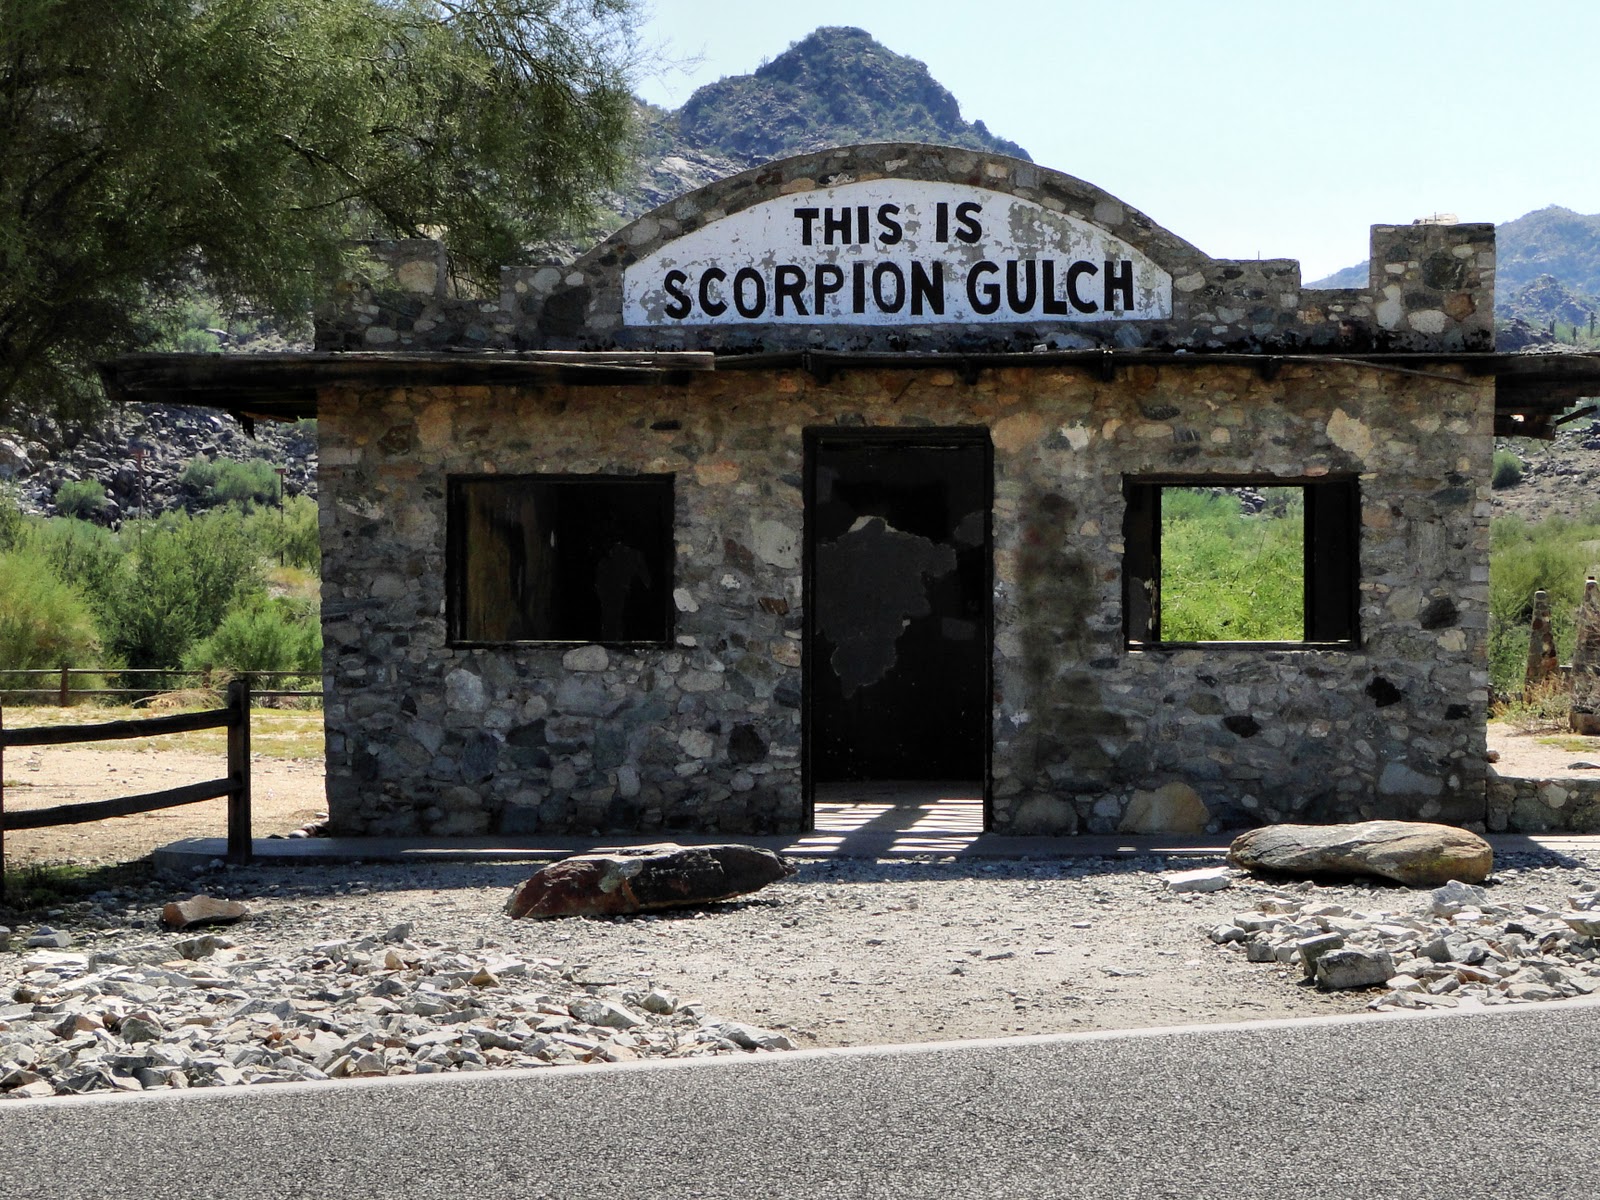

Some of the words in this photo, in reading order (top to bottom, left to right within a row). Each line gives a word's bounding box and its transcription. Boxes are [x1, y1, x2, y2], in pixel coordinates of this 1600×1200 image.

[794, 204, 901, 246] THIS
[936, 202, 983, 243] IS
[663, 260, 944, 319] SCORPION
[966, 259, 1135, 315] GULCH
